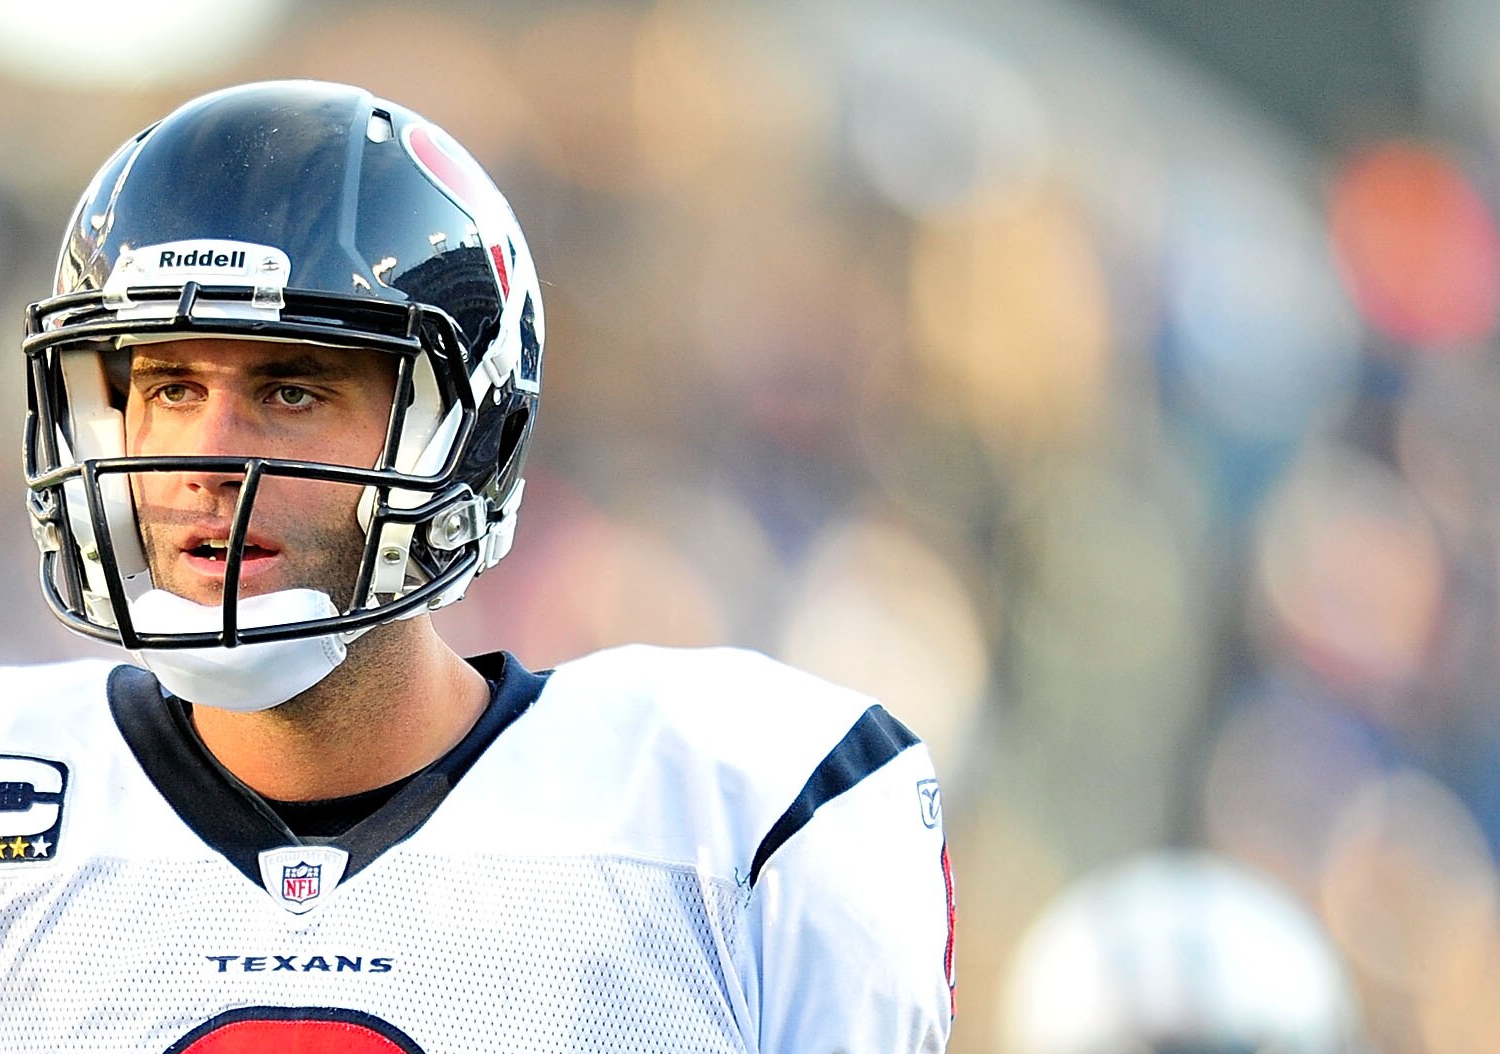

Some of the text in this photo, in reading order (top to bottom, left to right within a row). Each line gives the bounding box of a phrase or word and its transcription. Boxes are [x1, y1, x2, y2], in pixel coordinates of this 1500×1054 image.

[158, 250, 246, 269] Riddell
[285, 879, 317, 899] NFL
[205, 955, 395, 973] TEXANS
